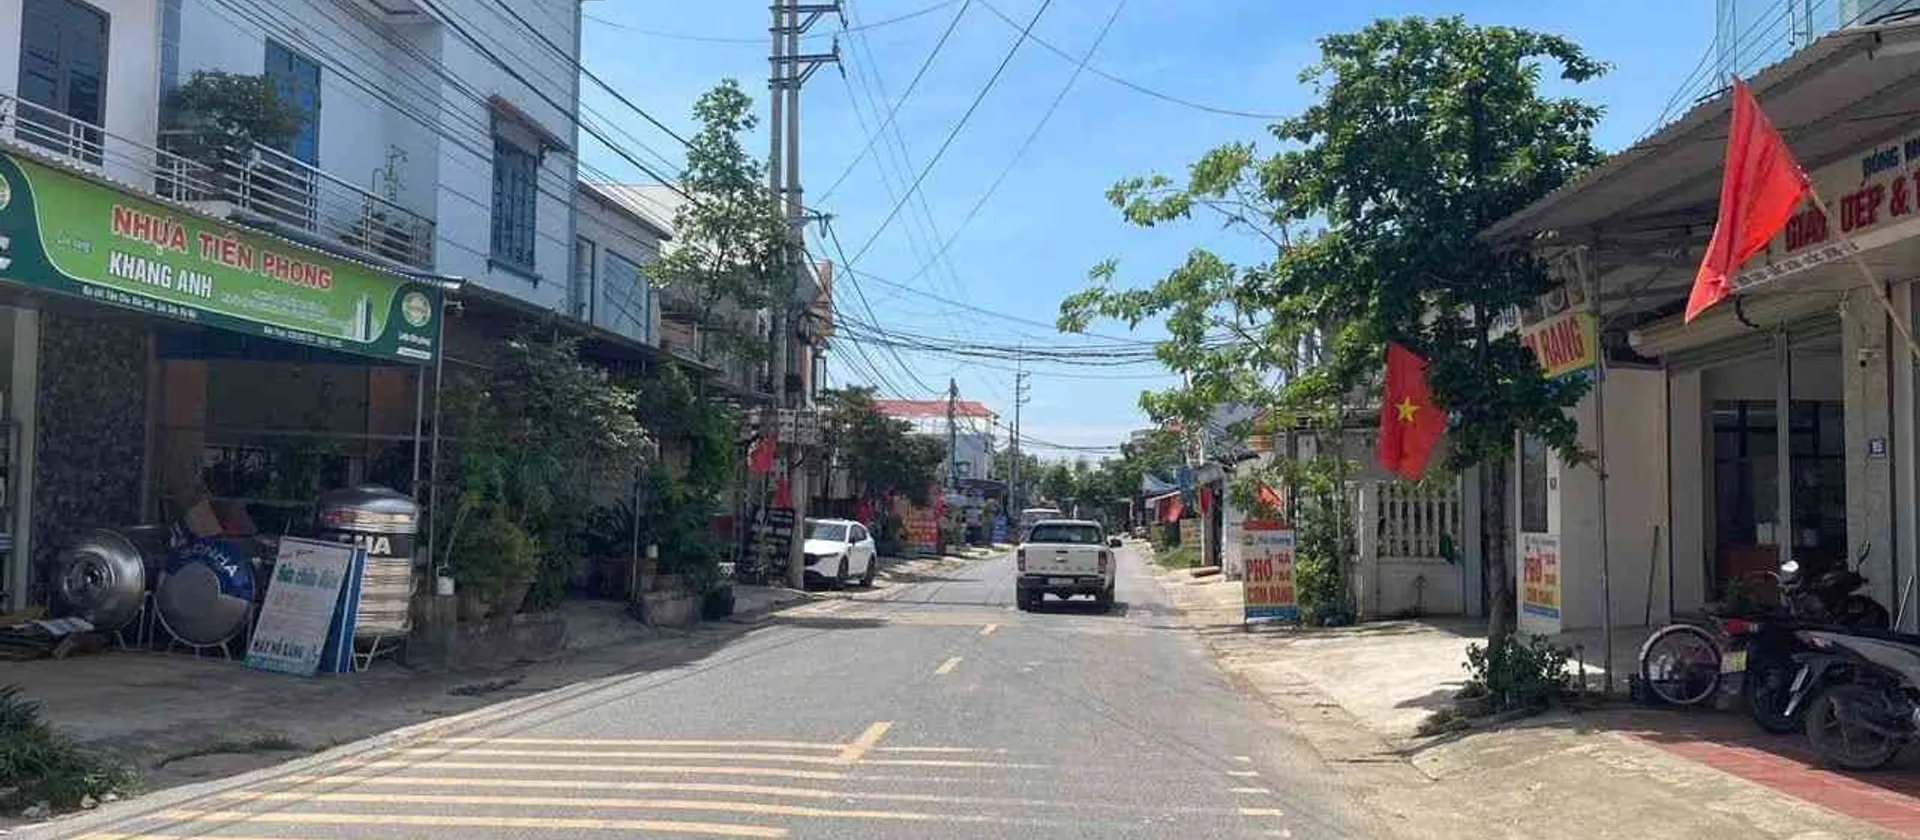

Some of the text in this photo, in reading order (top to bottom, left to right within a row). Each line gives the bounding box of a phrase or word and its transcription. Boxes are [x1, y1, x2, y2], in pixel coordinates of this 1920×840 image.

[109, 250, 213, 299] KHANG ANH
[111, 204, 188, 255] NHỰA
[262, 250, 333, 292] PHONG
